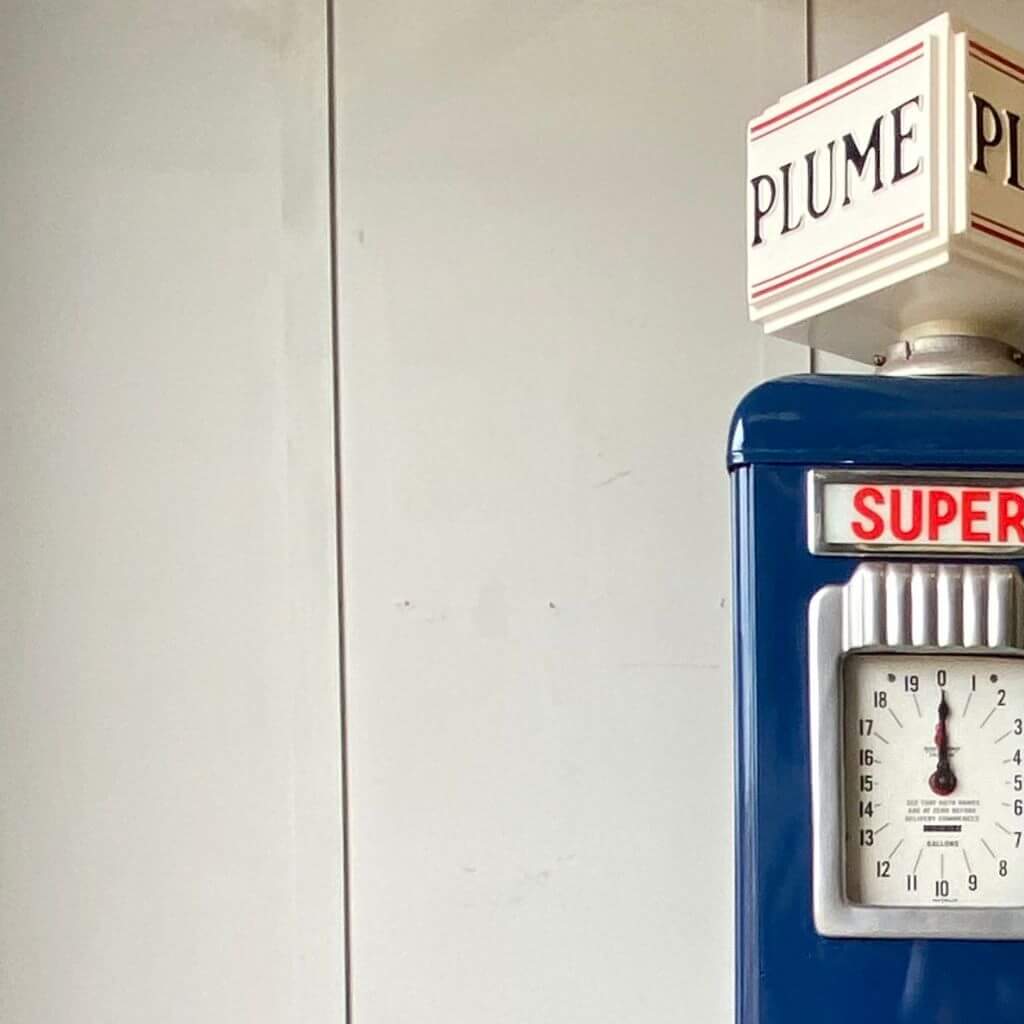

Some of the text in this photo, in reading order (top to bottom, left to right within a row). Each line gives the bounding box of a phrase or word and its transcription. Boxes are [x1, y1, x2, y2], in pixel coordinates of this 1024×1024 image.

[750, 95, 921, 248] PLUME
[904, 675, 919, 692] 19
[937, 670, 946, 687] 0
[971, 675, 976, 690] 1
[873, 691, 887, 708] 18
[997, 689, 1006, 706] 2
[859, 719, 873, 735] 17
[1013, 719, 1023, 735] 3
[859, 749, 873, 766] 16
[1012, 749, 1022, 765] 4
[859, 775, 873, 791] 15
[1013, 775, 1023, 791] 5
[859, 801, 873, 818] 14
[1013, 800, 1023, 817] 6
[859, 830, 874, 846] 13
[1014, 832, 1022, 848] 7
[876, 861, 890, 877] 12
[998, 860, 1008, 876] 8
[907, 875, 917, 891] 11
[935, 880, 949, 897] 10
[967, 875, 977, 891] 9
